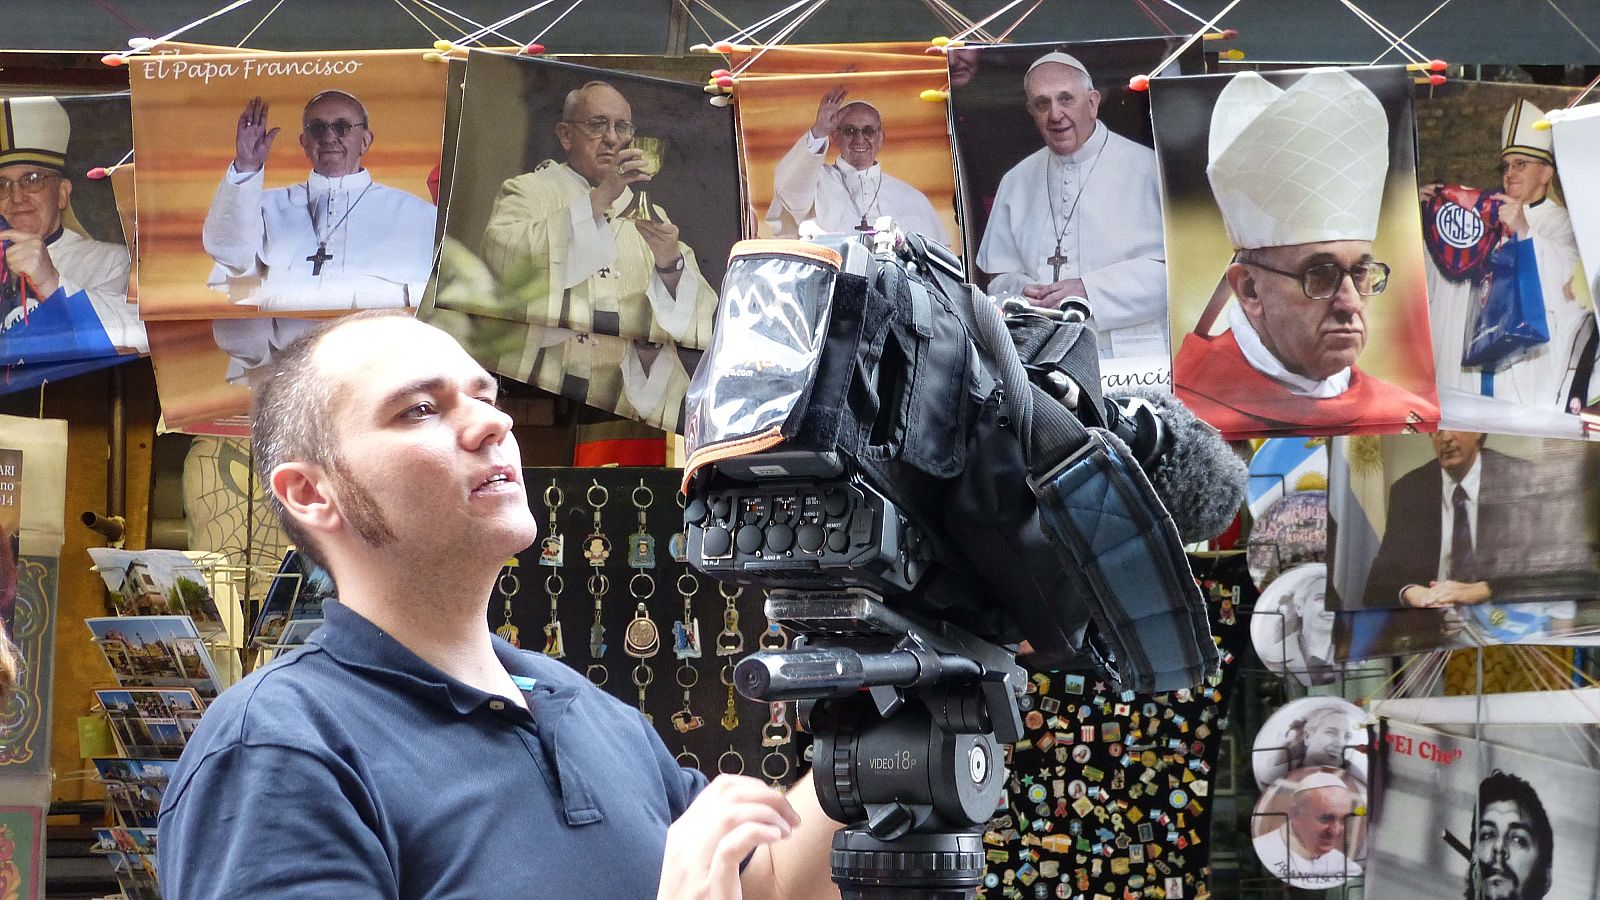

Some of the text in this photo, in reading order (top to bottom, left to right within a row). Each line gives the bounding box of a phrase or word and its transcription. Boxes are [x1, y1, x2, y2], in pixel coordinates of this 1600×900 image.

[143, 57, 363, 85] El Papa Francisco
[0, 494, 14, 506] 14
[869, 757, 894, 770] VIDEO
